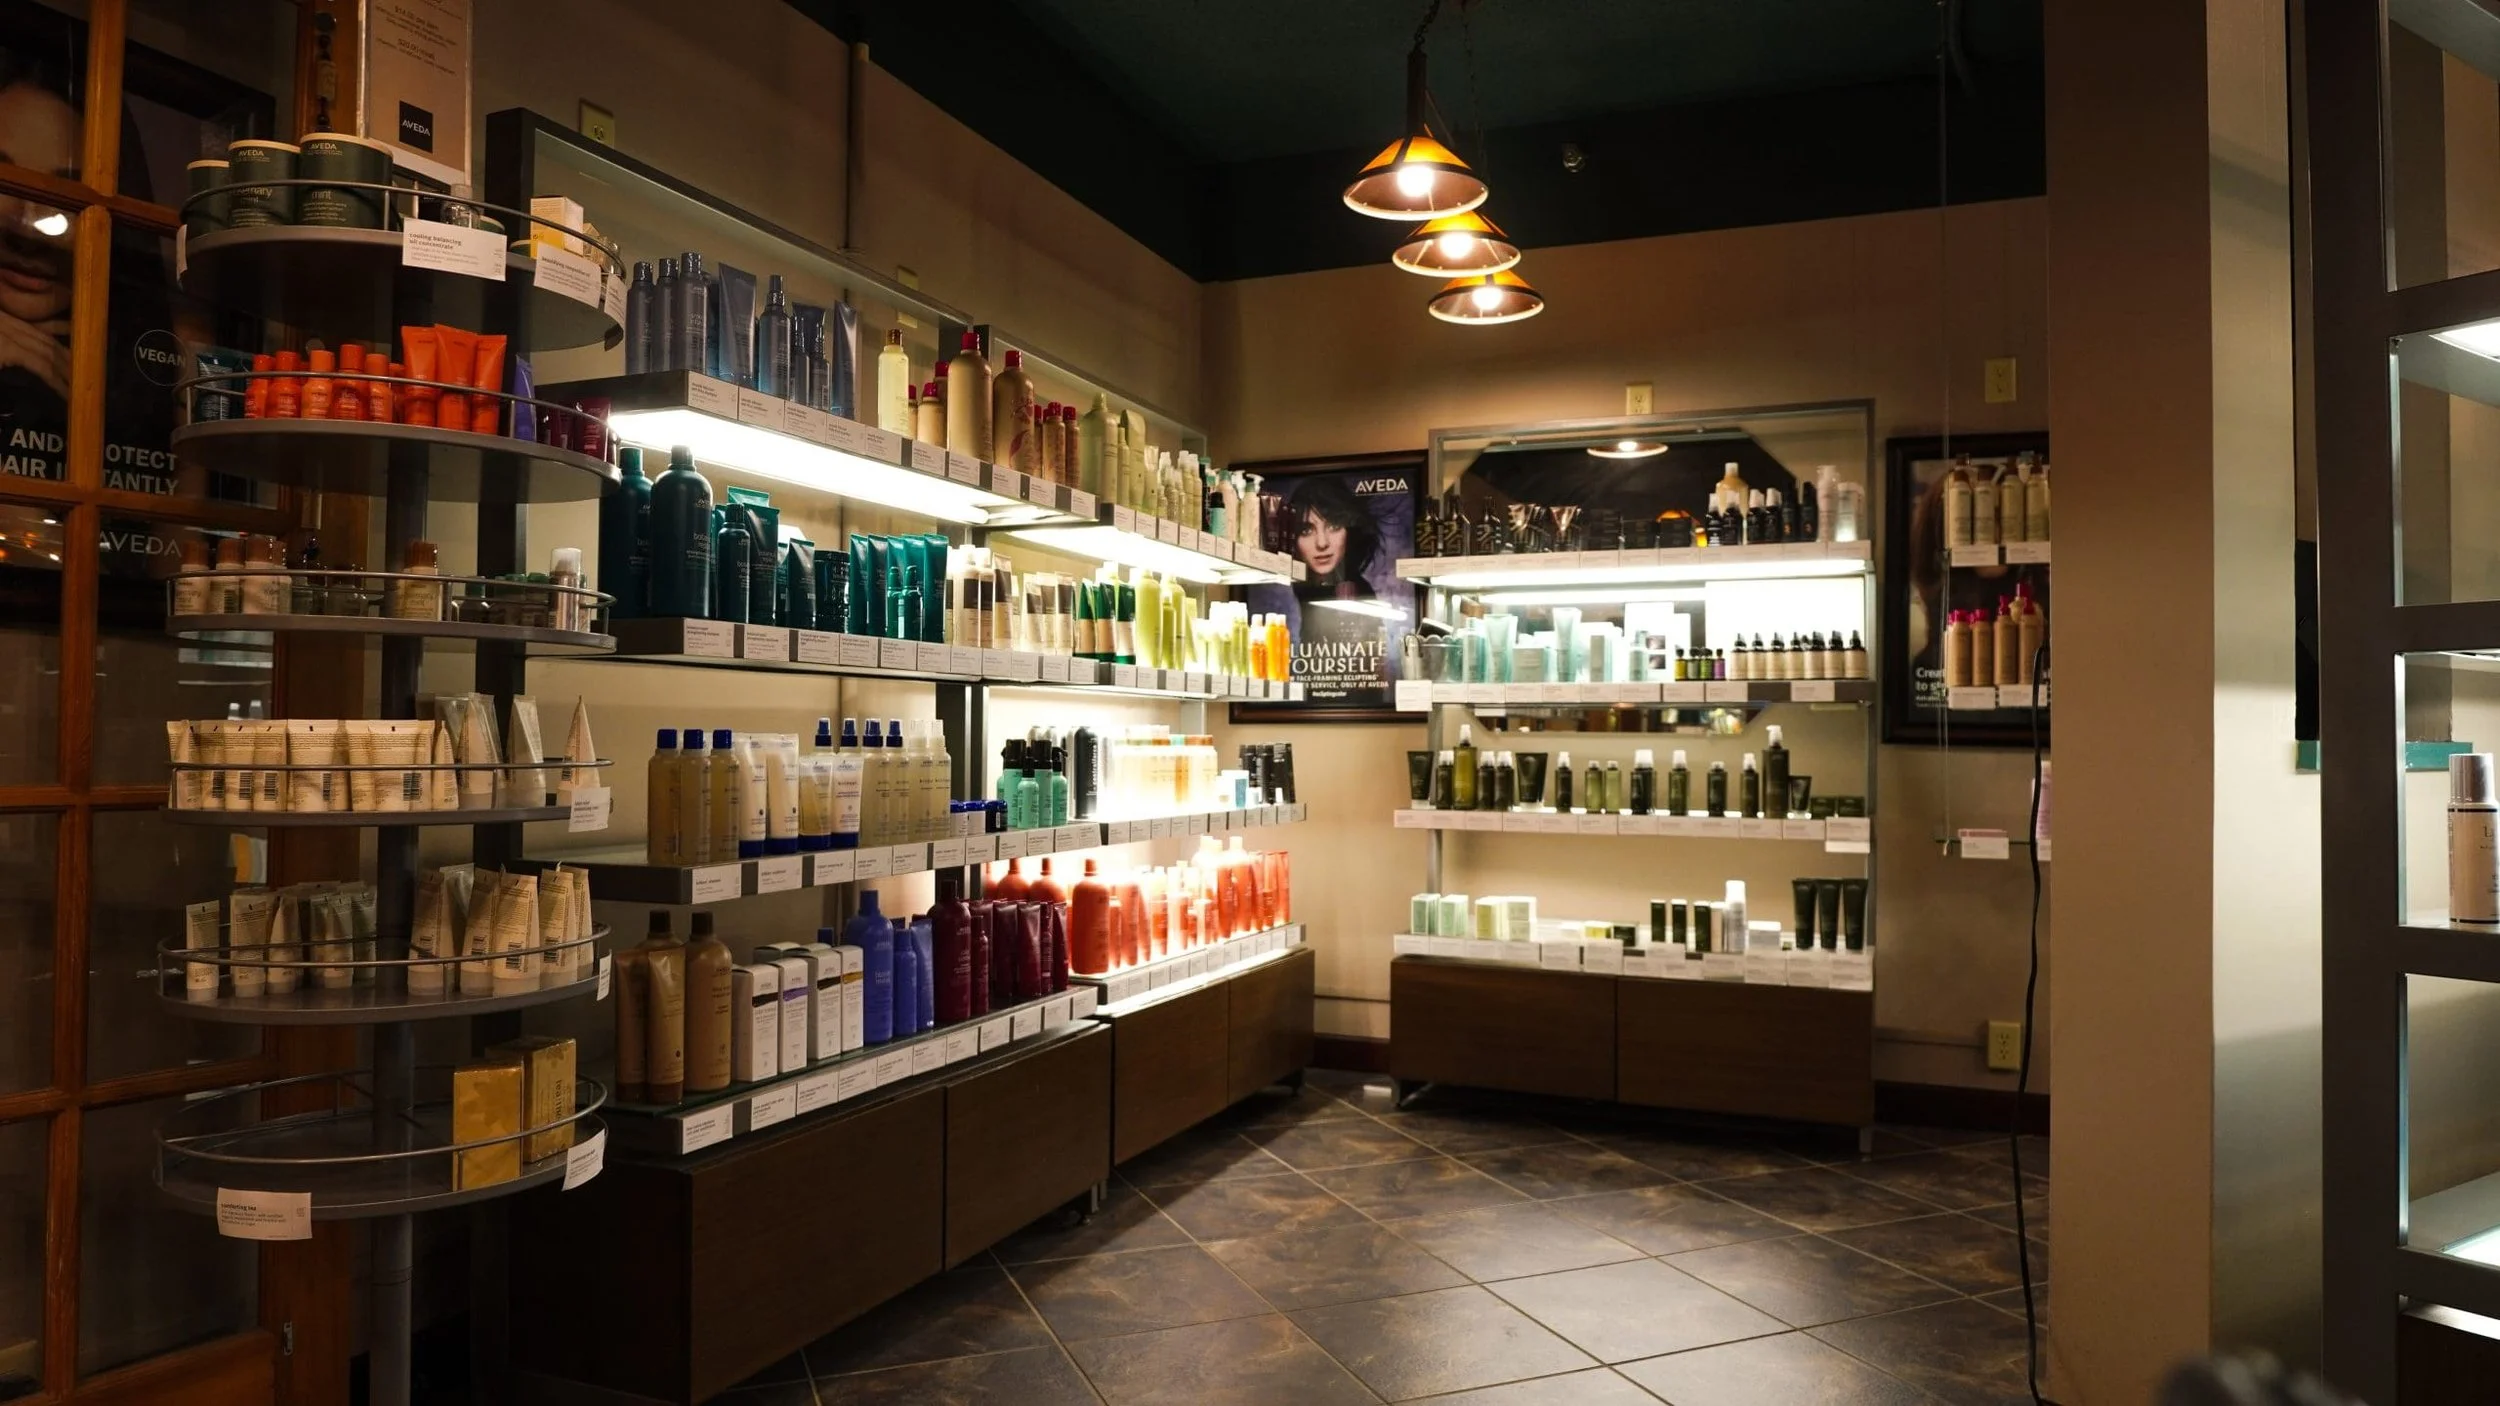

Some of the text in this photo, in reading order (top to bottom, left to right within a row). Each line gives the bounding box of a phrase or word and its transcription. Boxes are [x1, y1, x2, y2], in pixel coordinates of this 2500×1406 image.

[402, 119, 431, 137] AVEDA
[138, 345, 187, 368] VEGAN
[9, 428, 178, 472] AND OTECT
[1355, 478, 1409, 493] AVEDA
[1291, 657, 1379, 674] OURSELF
